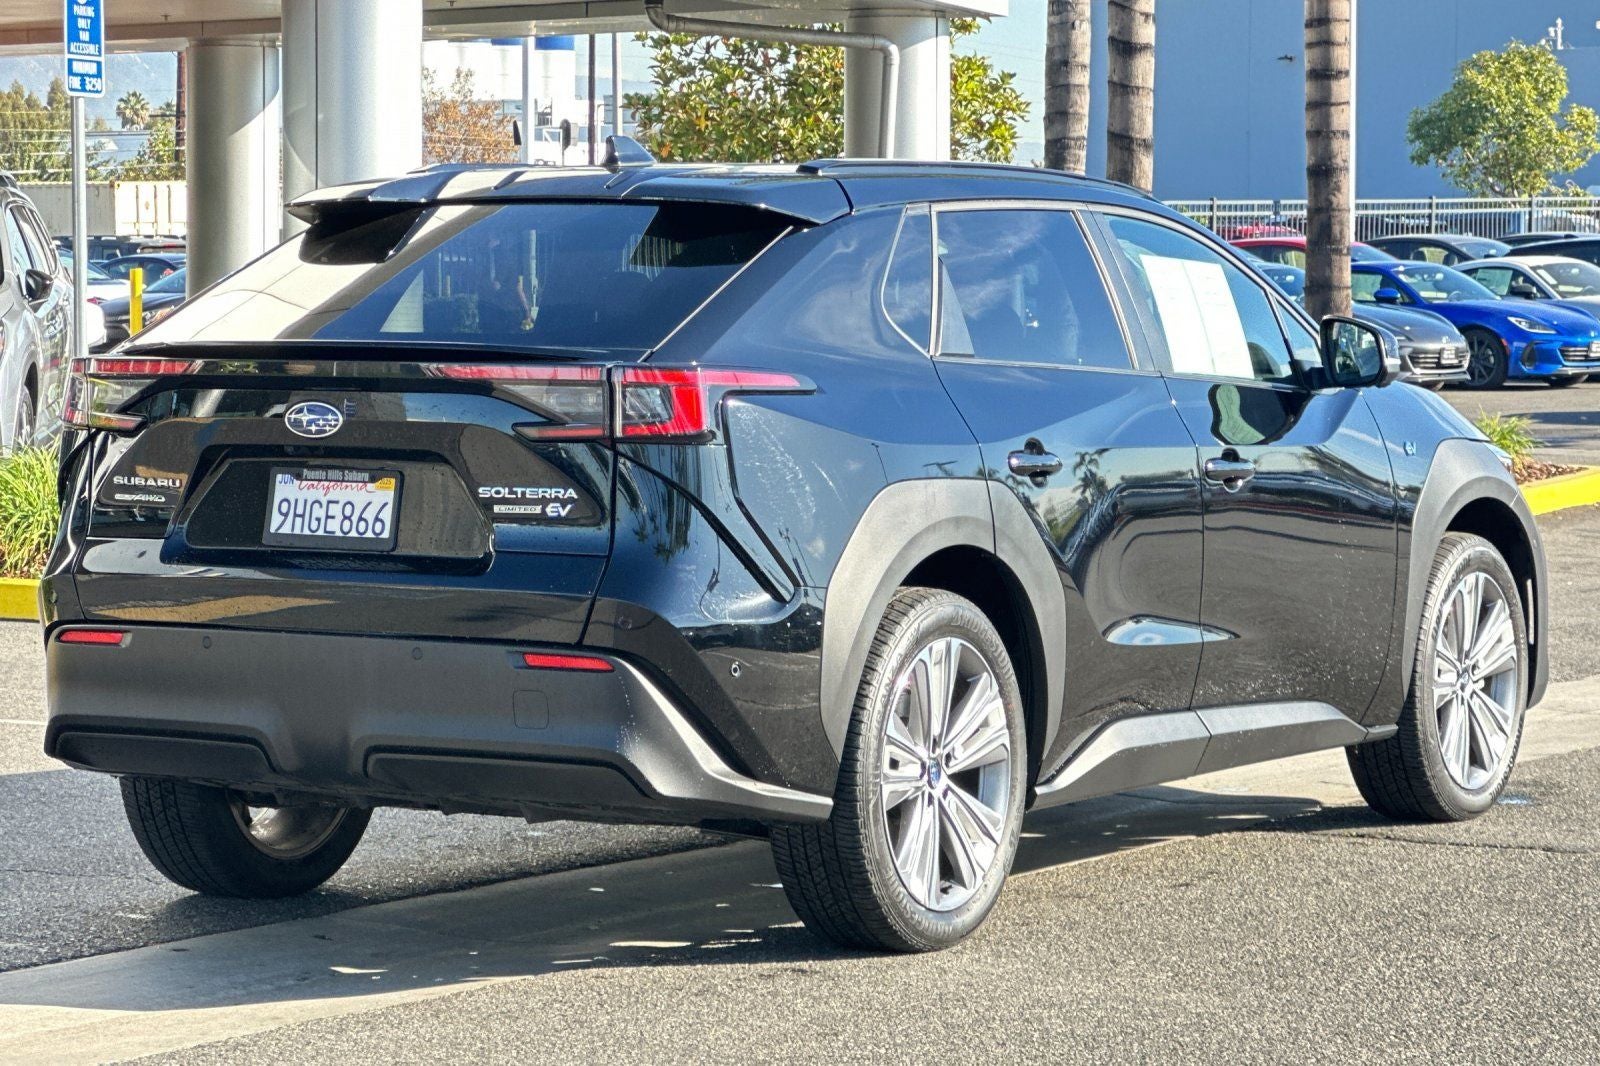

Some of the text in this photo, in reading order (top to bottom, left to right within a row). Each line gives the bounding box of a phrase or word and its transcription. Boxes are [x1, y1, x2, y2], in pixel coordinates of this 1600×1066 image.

[73, 4, 95, 18] PARKING
[77, 18, 91, 29] ONLY
[79, 30, 90, 42] VAN
[70, 41, 100, 55] ACCESSIBLE
[68, 76, 102, 91] FINE $250
[113, 475, 181, 488] SUBARU
[278, 475, 295, 485] JUN
[302, 469, 369, 482] Puente Hills Subaru
[298, 480, 376, 496] California
[477, 486, 578, 499] SOLTERRA
[545, 502, 575, 517] EV
[274, 497, 389, 537] 9HGE866
